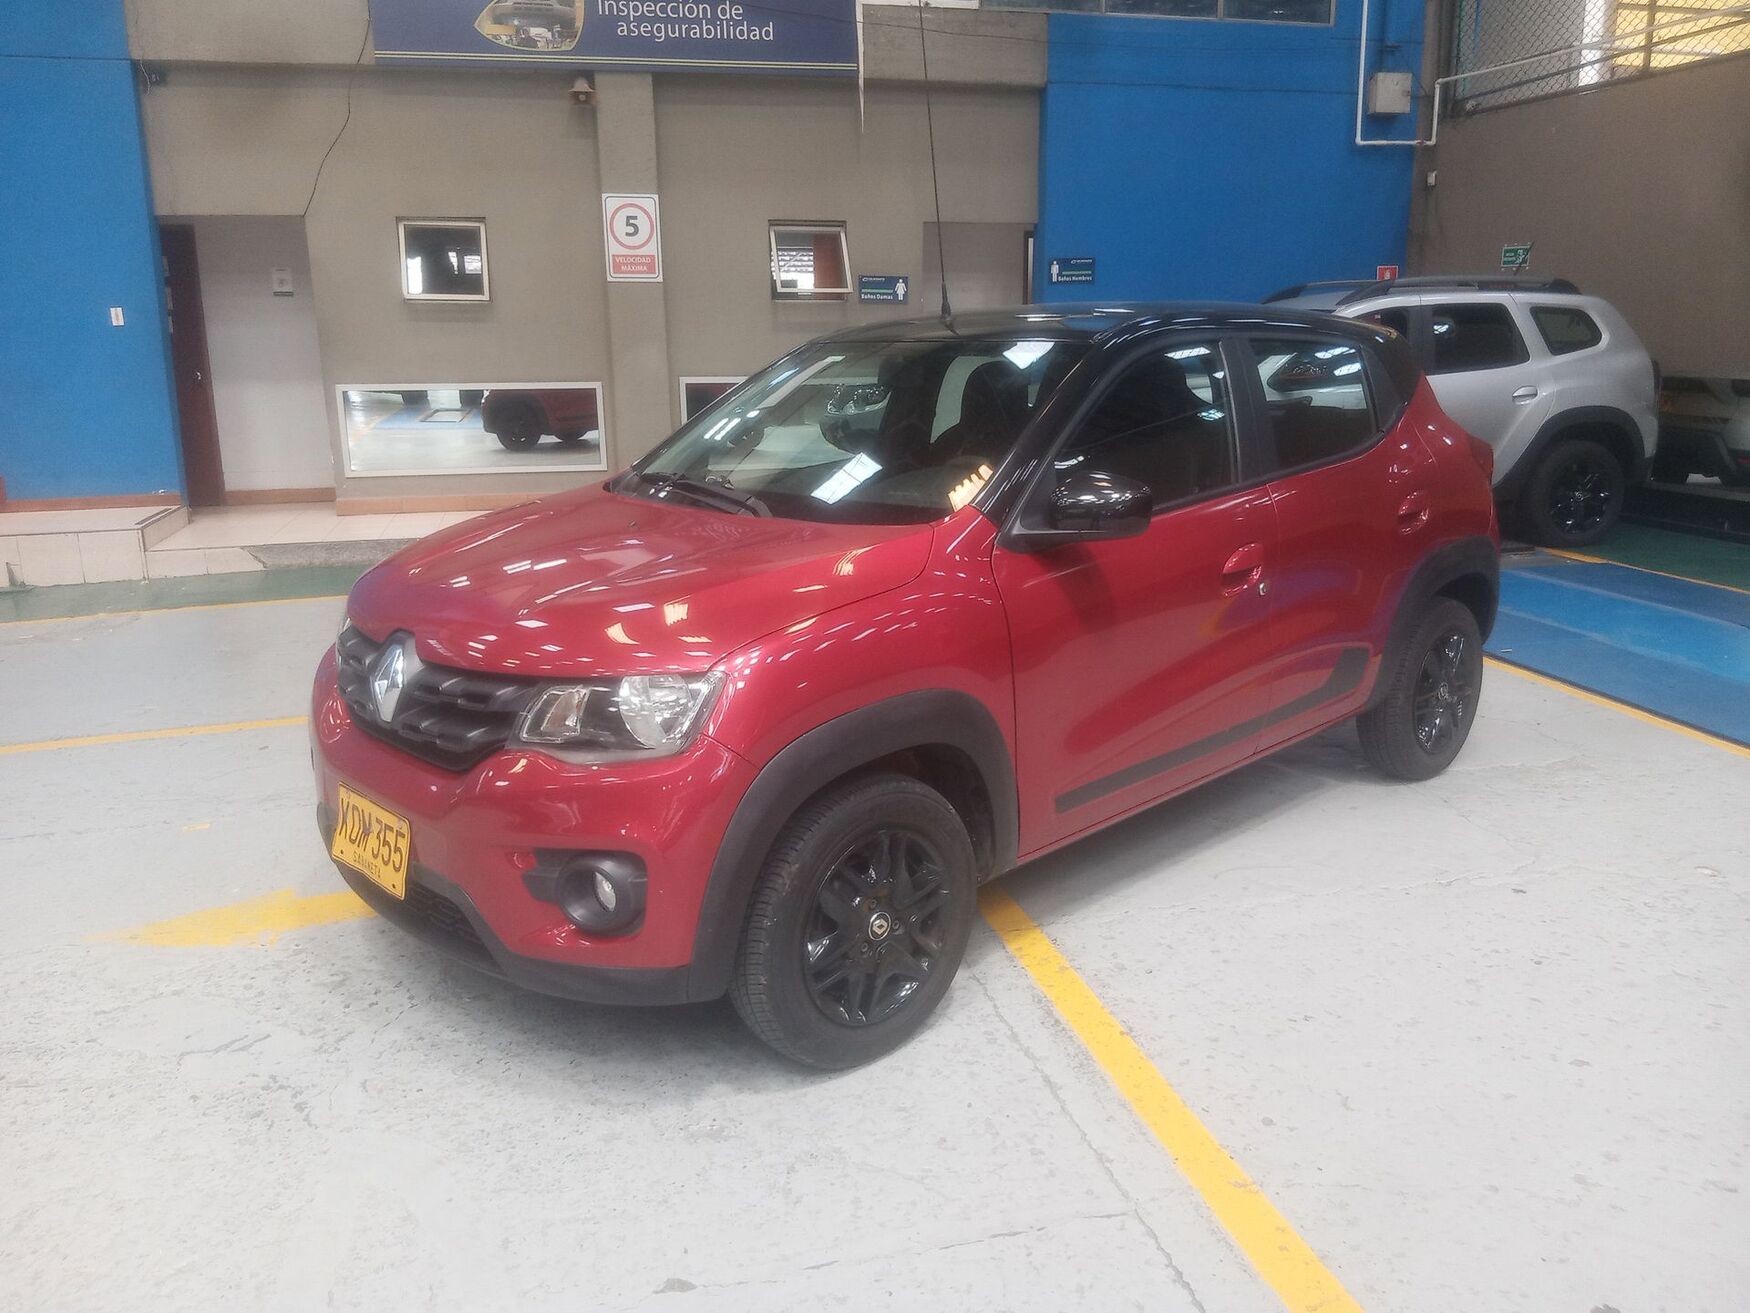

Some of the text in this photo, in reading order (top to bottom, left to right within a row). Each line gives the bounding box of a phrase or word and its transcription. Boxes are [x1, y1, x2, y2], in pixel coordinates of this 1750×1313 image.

[598, 0, 743, 21] Inspección de
[617, 20, 774, 42] asegurabilidad
[625, 215, 640, 237] 5
[615, 256, 651, 264] VELOCIDAD
